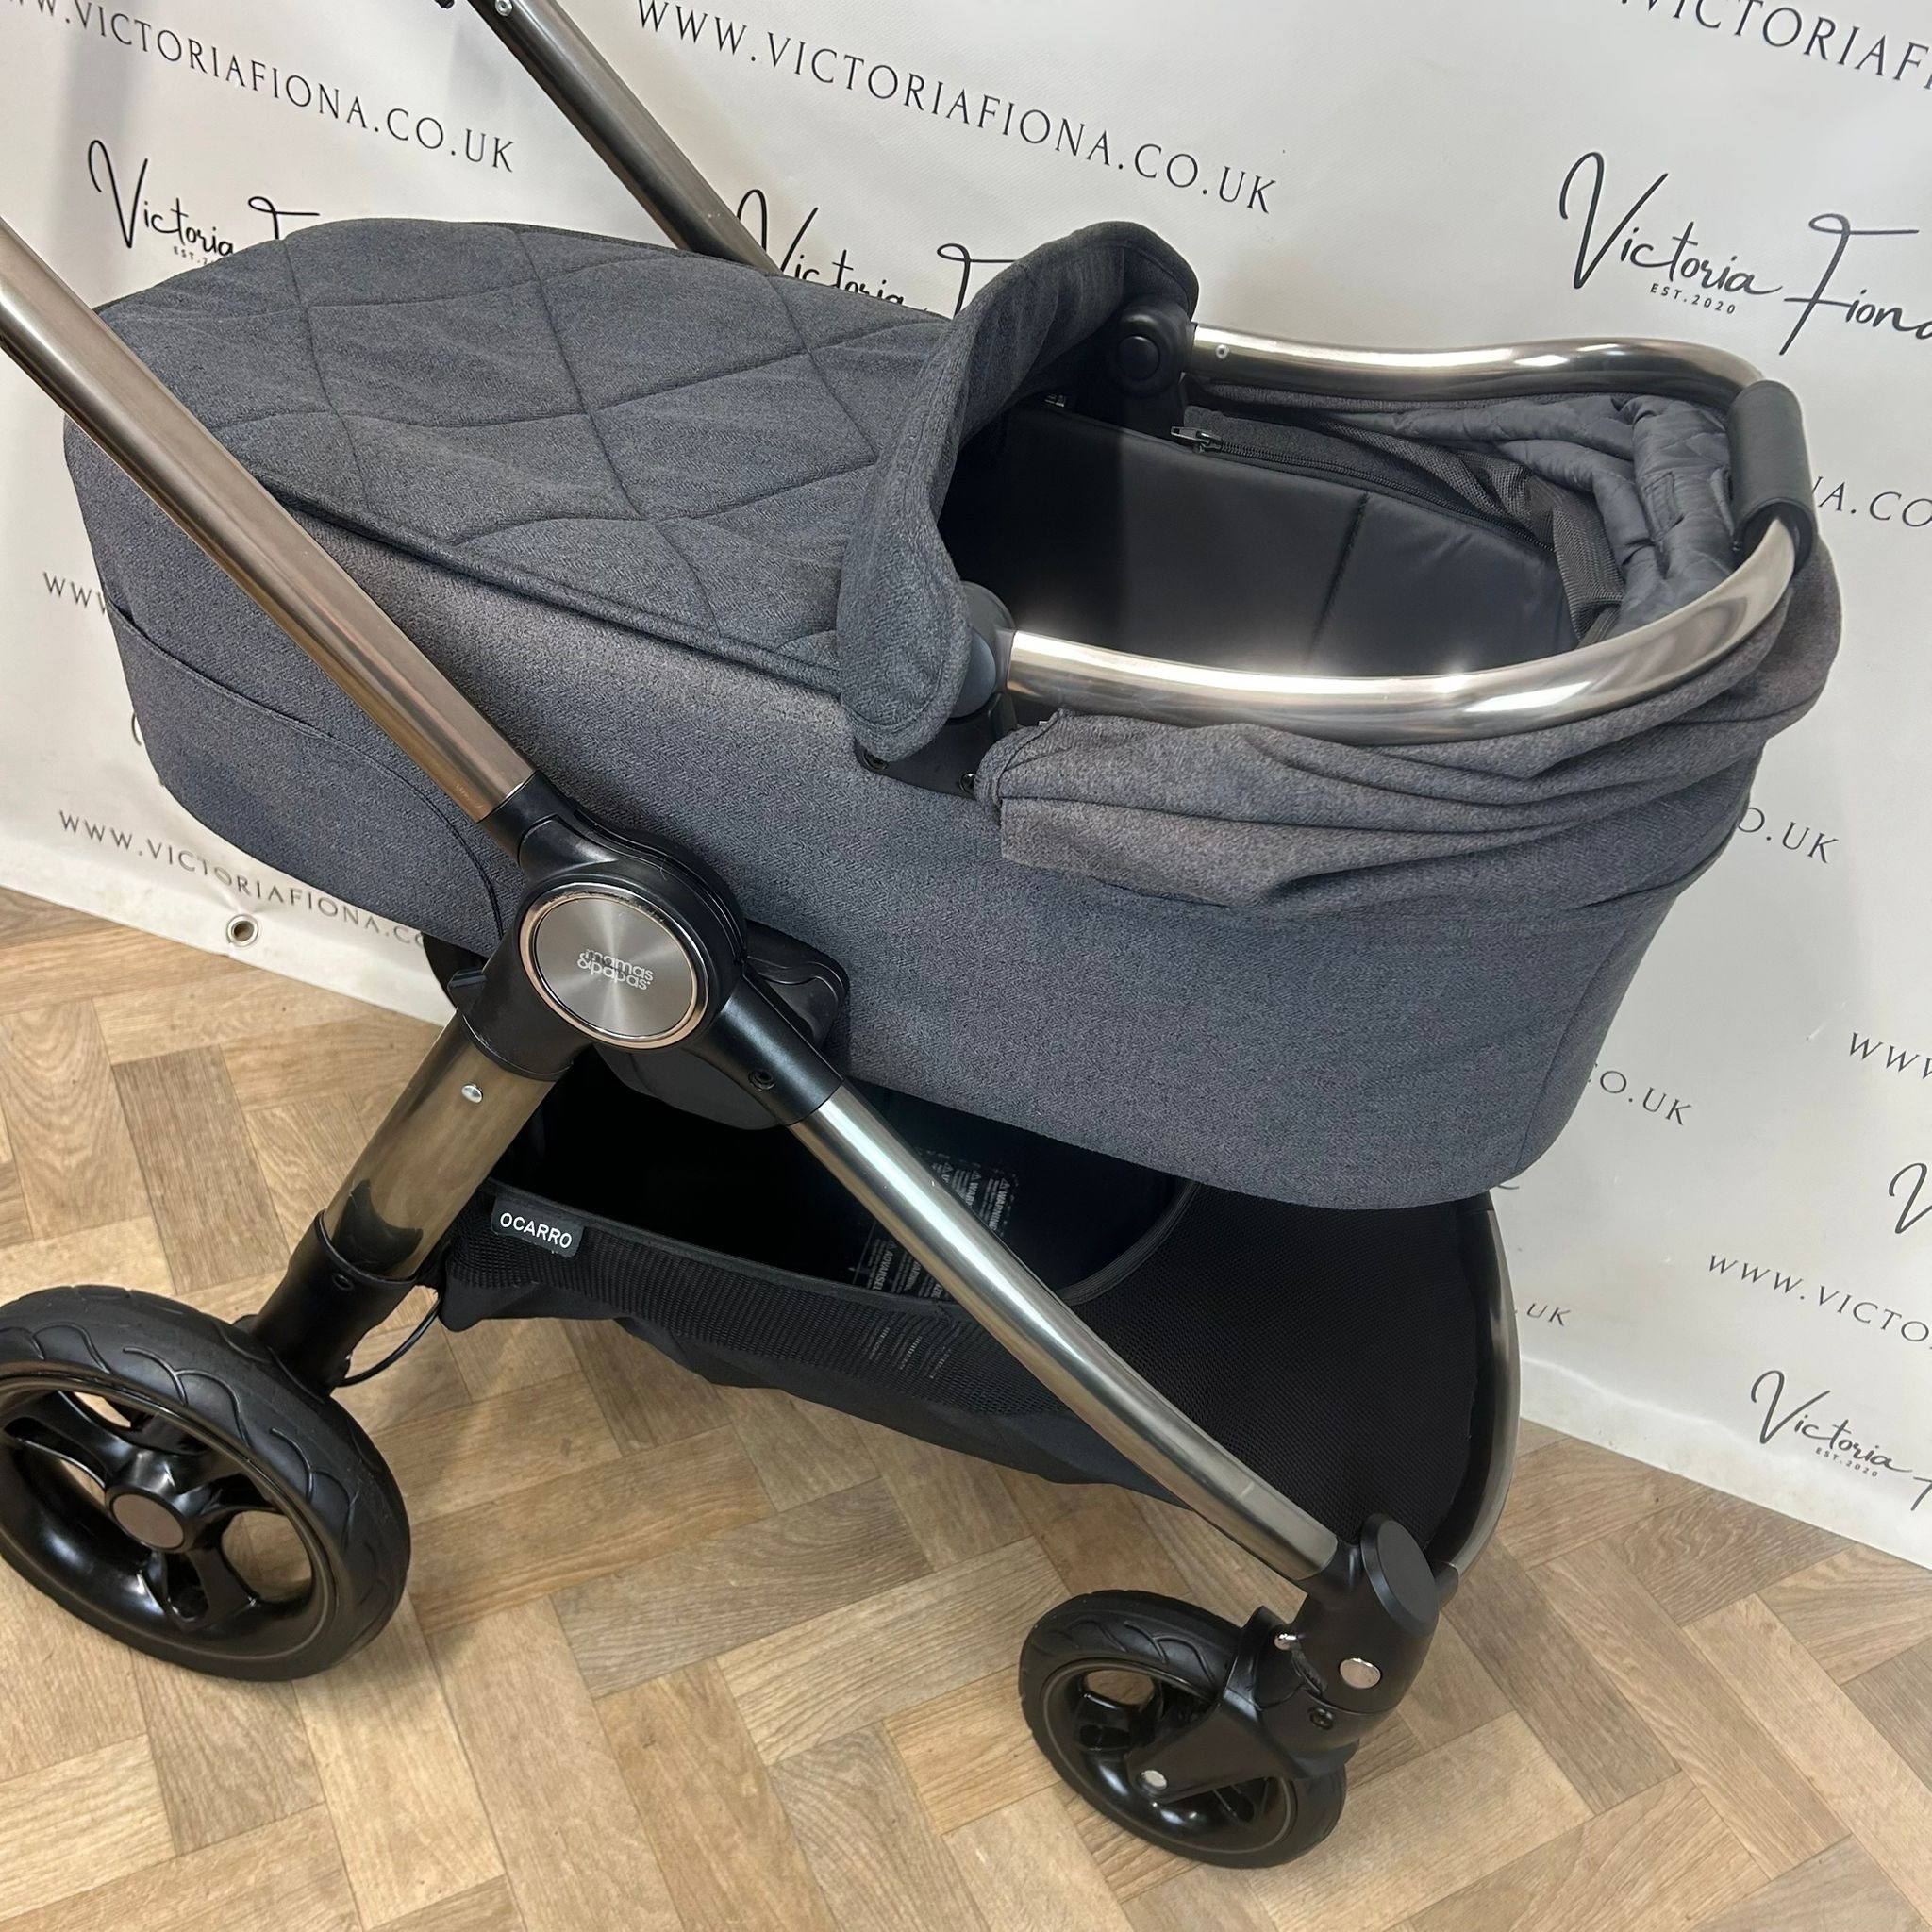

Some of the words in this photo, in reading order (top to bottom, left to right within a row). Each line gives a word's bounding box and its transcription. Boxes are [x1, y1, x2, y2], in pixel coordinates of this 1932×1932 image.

[8, 0, 514, 173] .VICTORIAFIONA.CO.UK
[638, 0, 1276, 214] WWW.VICTORIAFIONA.CO.UK
[88, 140, 234, 257] Victoria
[1559, 151, 1783, 290] Victoria
[1650, 282, 1737, 315] EST.2020
[585, 948, 654, 981] mamas
[1587, 1062, 1692, 1125] O.UK
[500, 1212, 573, 1249] OCARRO
[1709, 1255, 1932, 1349] WWW.VICTO
[1751, 1369, 1913, 1473] Victoria
[1815, 1446, 1878, 1478] EST.2020
